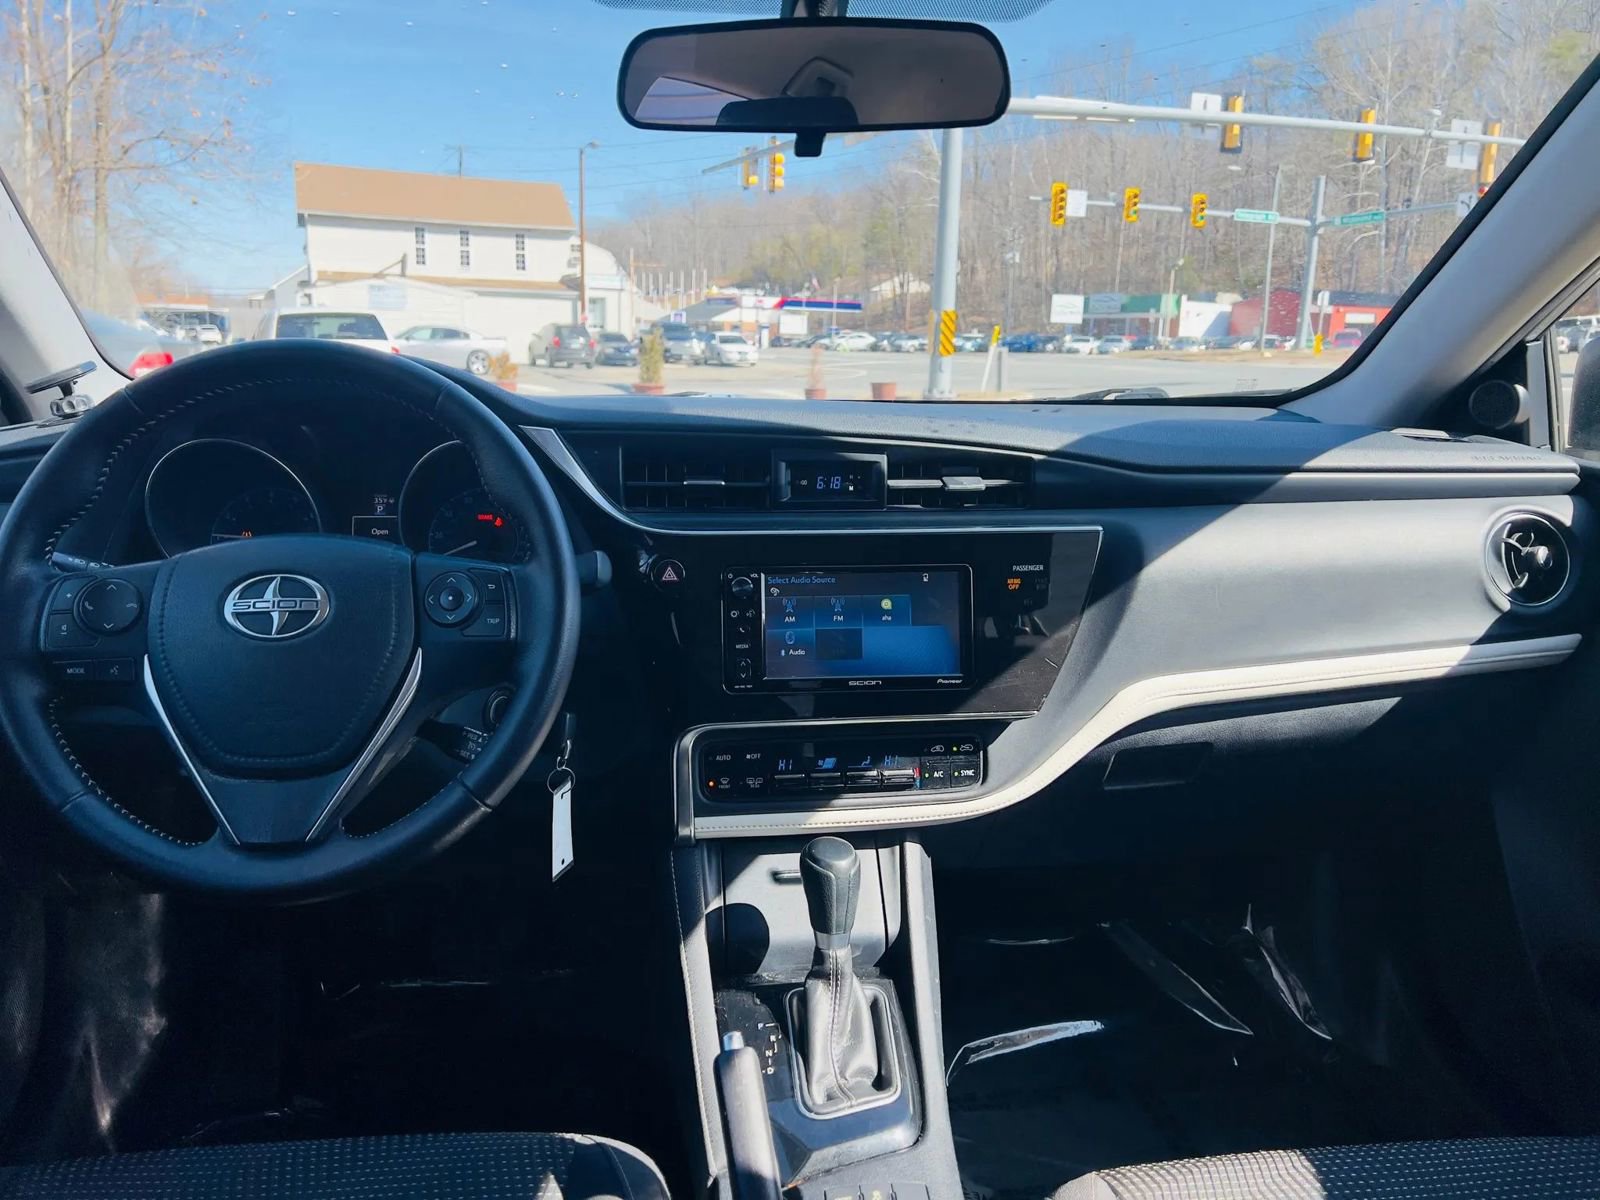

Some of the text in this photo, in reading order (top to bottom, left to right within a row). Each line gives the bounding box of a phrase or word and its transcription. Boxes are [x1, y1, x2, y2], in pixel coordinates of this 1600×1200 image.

[816, 476, 841, 489] 6:18
[376, 506, 383, 514] P
[371, 528, 389, 536] Open
[767, 576, 789, 584] Select
[790, 576, 811, 584] Audio
[232, 599, 319, 611] SCION
[788, 648, 806, 656] Audio
[933, 770, 944, 778] A/C
[960, 769, 975, 777] SYNC
